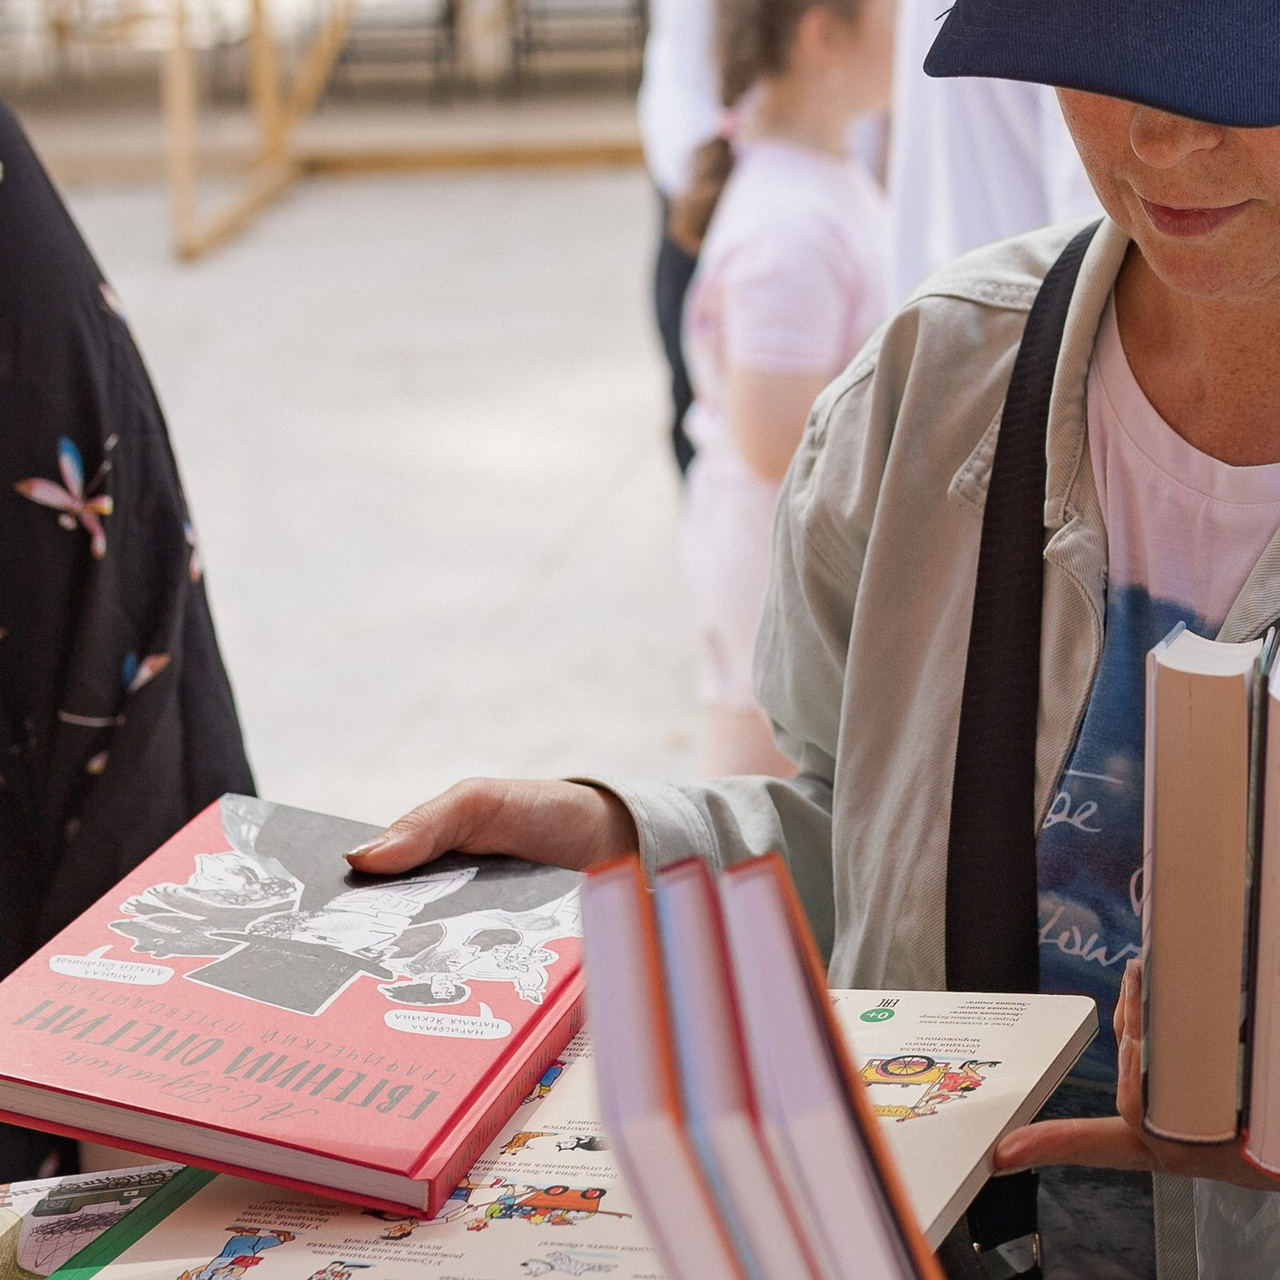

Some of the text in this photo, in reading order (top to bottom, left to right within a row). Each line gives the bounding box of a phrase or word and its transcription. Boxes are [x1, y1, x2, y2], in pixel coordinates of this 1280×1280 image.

[84, 970, 137, 981] НАПИСАЛ
[394, 1013, 500, 1029] НАТАЛЬЯ ЯСКИНА
[13, 1000, 225, 1067] ОНЕГИН
[56, 980, 456, 1087] ГРАФИЧЕСКИЙ ПУТЕВОДИТЕЛЬ
[411, 1024, 484, 1036] НАРИСОВАЛА
[912, 1034, 982, 1043] мороженого.
[897, 1045, 943, 1053] продала
[223, 1046, 441, 1121] ЕВГЕНИЙ
[245, 1203, 341, 1218] собралась купить
[303, 1202, 337, 1210] новое
[234, 1216, 278, 1225] сегодня
[271, 1213, 330, 1223] выходной,
[276, 1220, 313, 1229] Ирмы
[304, 1240, 371, 1252] пригласила
[339, 1236, 383, 1246] друзей.
[309, 1248, 339, 1256] день
[403, 1248, 464, 1259] рождения,
